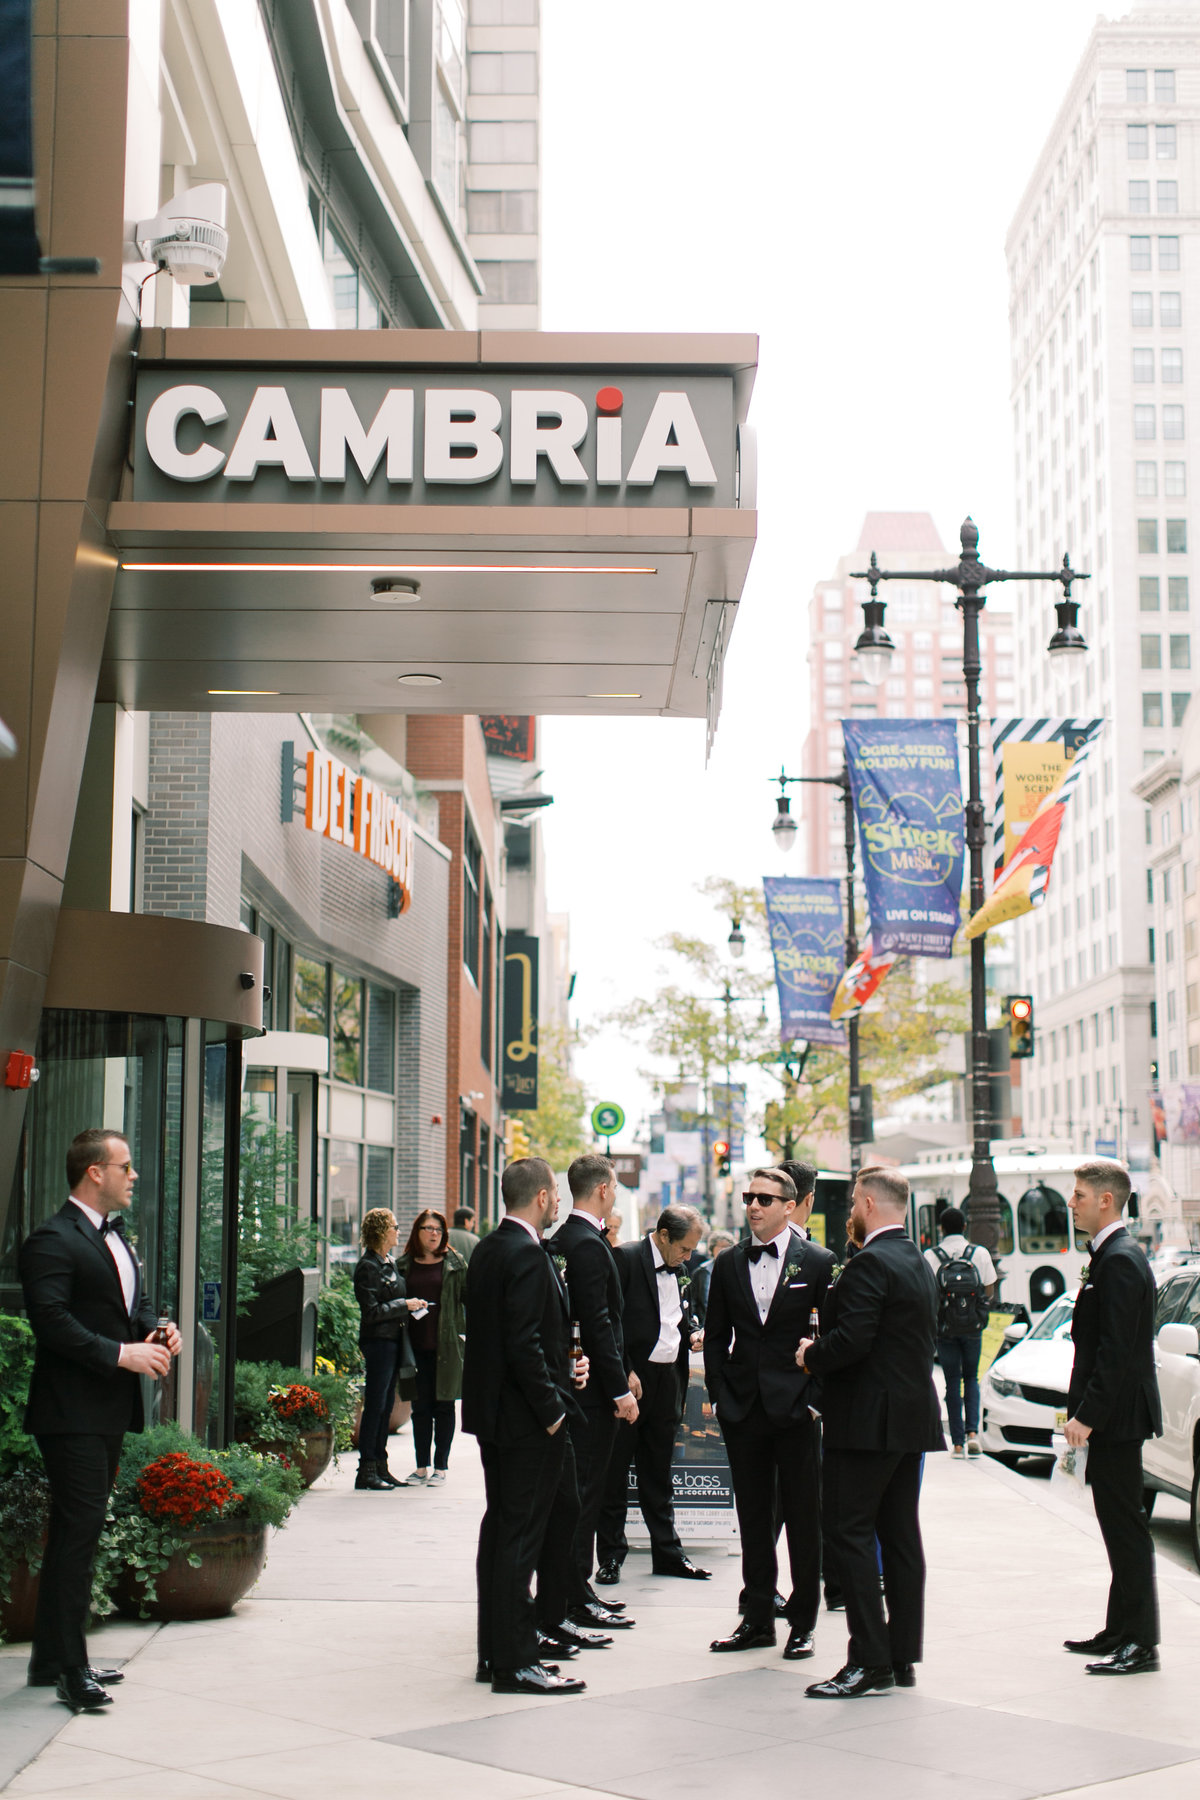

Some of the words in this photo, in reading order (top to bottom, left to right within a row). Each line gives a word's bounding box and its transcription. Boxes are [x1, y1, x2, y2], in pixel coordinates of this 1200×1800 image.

[859, 745, 946, 757] OGRE-SIZED
[1041, 764, 1062, 772] THE
[1024, 785, 1053, 793] SCEN
[307, 750, 355, 849] DEL
[910, 909, 928, 921] ON
[672, 1474, 683, 1485] &
[684, 1471, 721, 1489] bass
